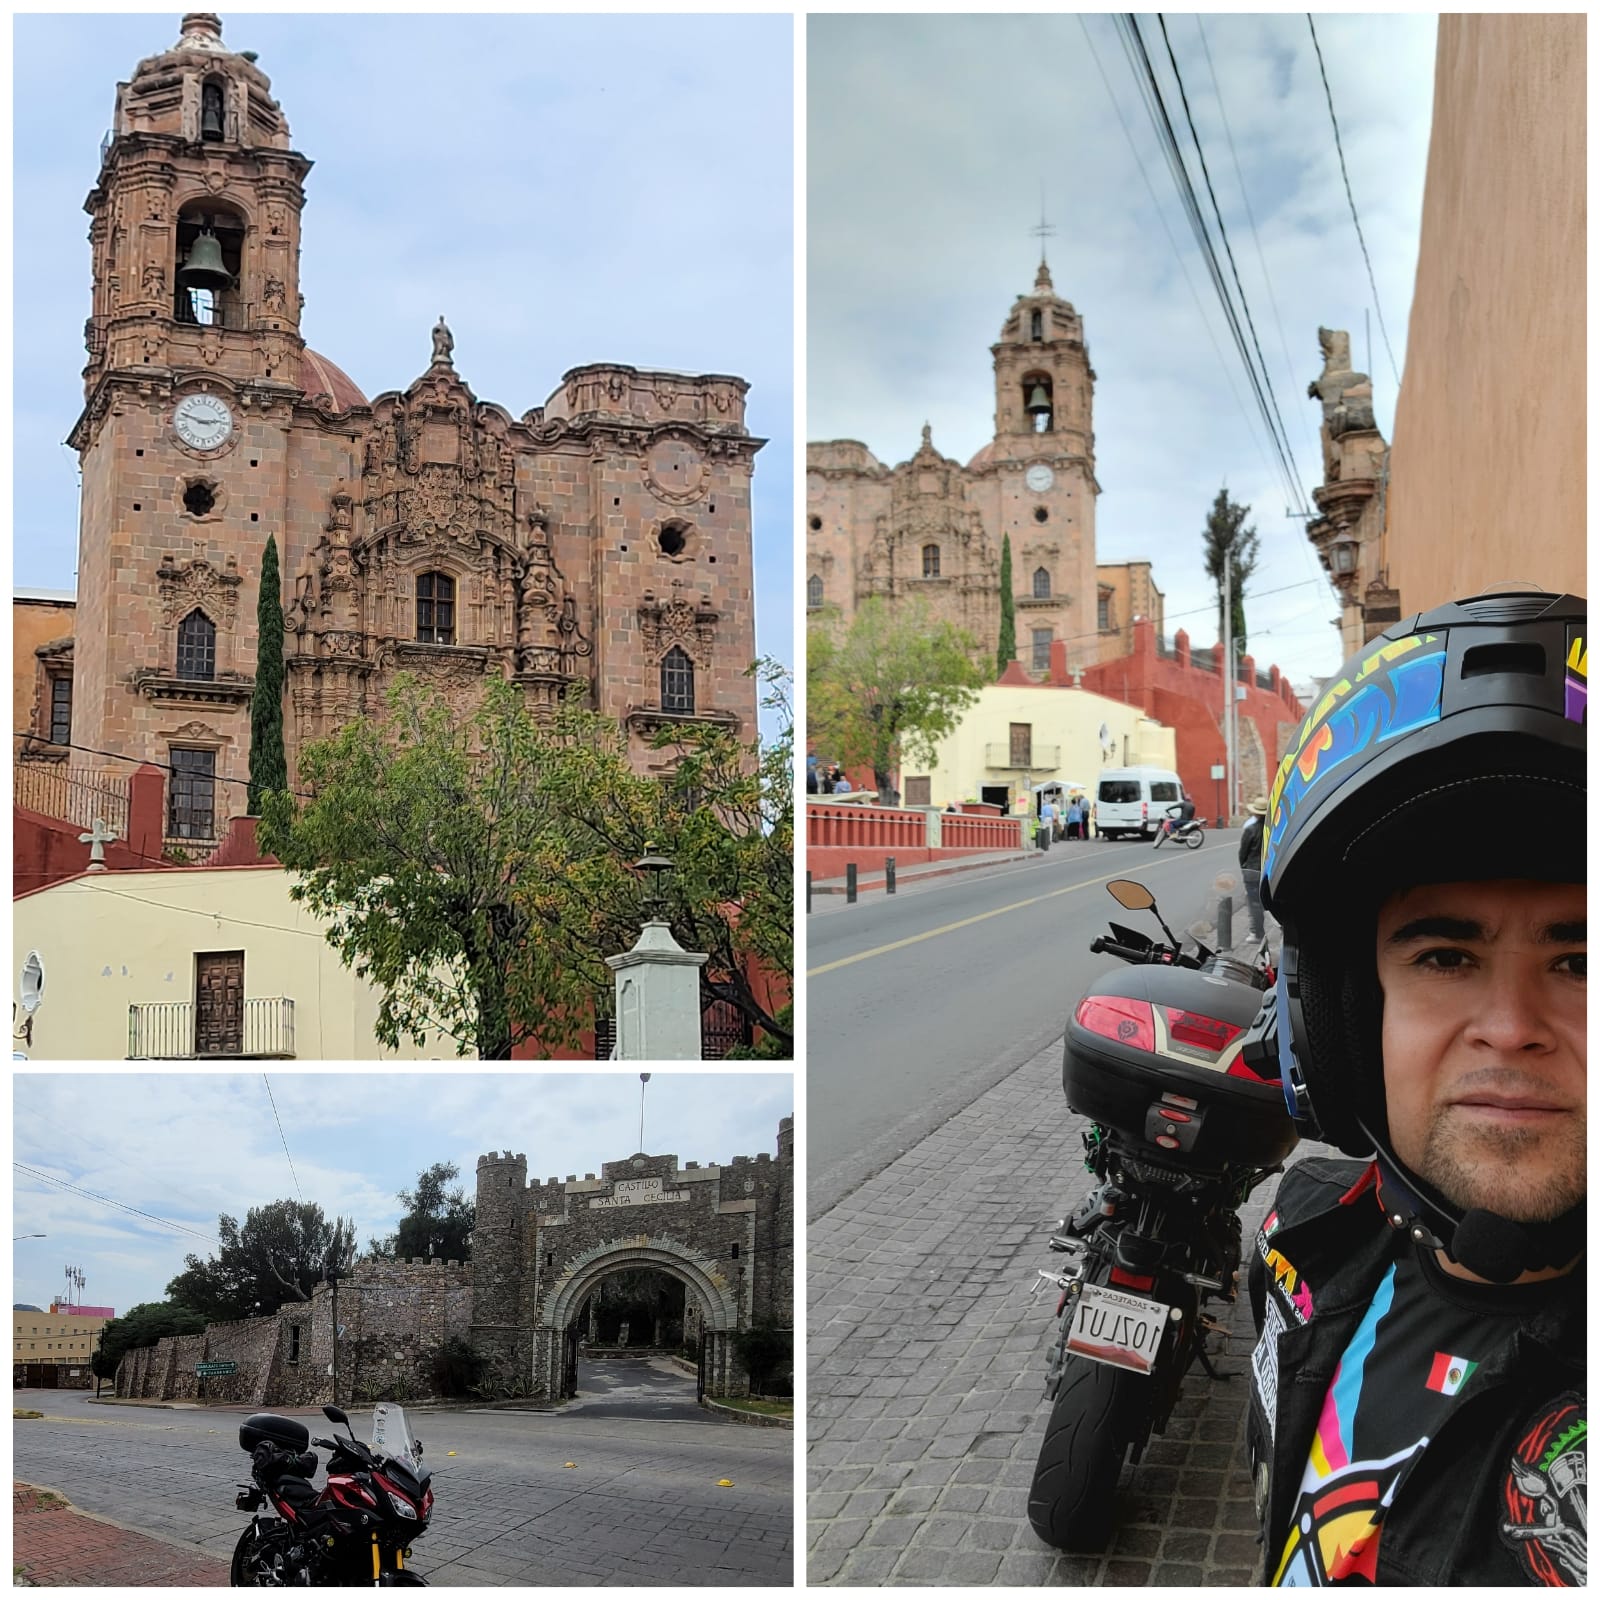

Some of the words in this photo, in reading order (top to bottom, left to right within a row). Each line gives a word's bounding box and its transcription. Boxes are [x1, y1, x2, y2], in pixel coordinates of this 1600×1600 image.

[618, 1180, 658, 1192] CASTILLO
[598, 1195, 631, 1206] SANTA
[643, 1191, 681, 1202] CECILIA
